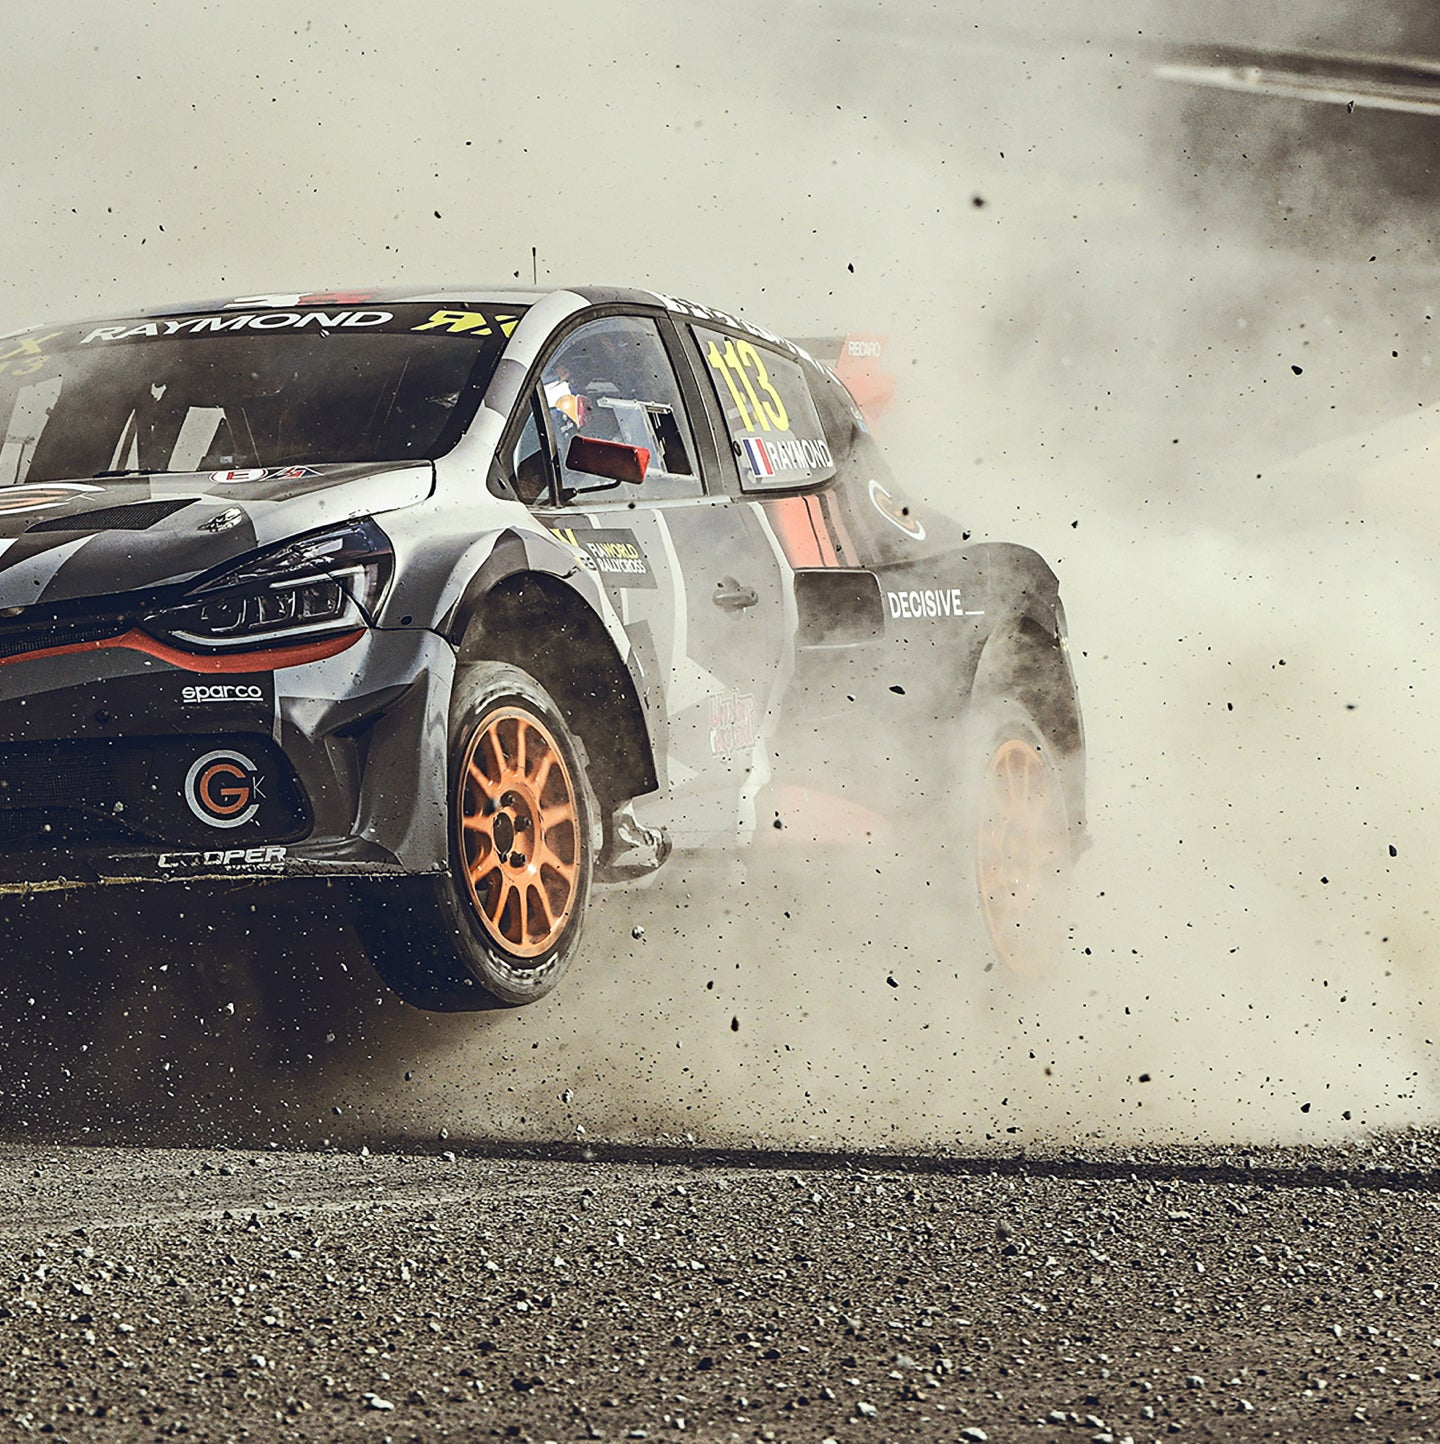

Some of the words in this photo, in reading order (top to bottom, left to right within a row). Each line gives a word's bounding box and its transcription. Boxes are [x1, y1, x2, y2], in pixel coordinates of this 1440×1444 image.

[79, 311, 394, 344] RAYMOND
[848, 340, 881, 358] RECARO
[707, 339, 790, 432] 113
[765, 438, 833, 471] RAYMOND
[601, 543, 639, 559] WORLD
[597, 558, 647, 574] RALLYCROSS
[182, 685, 264, 702] sparco
